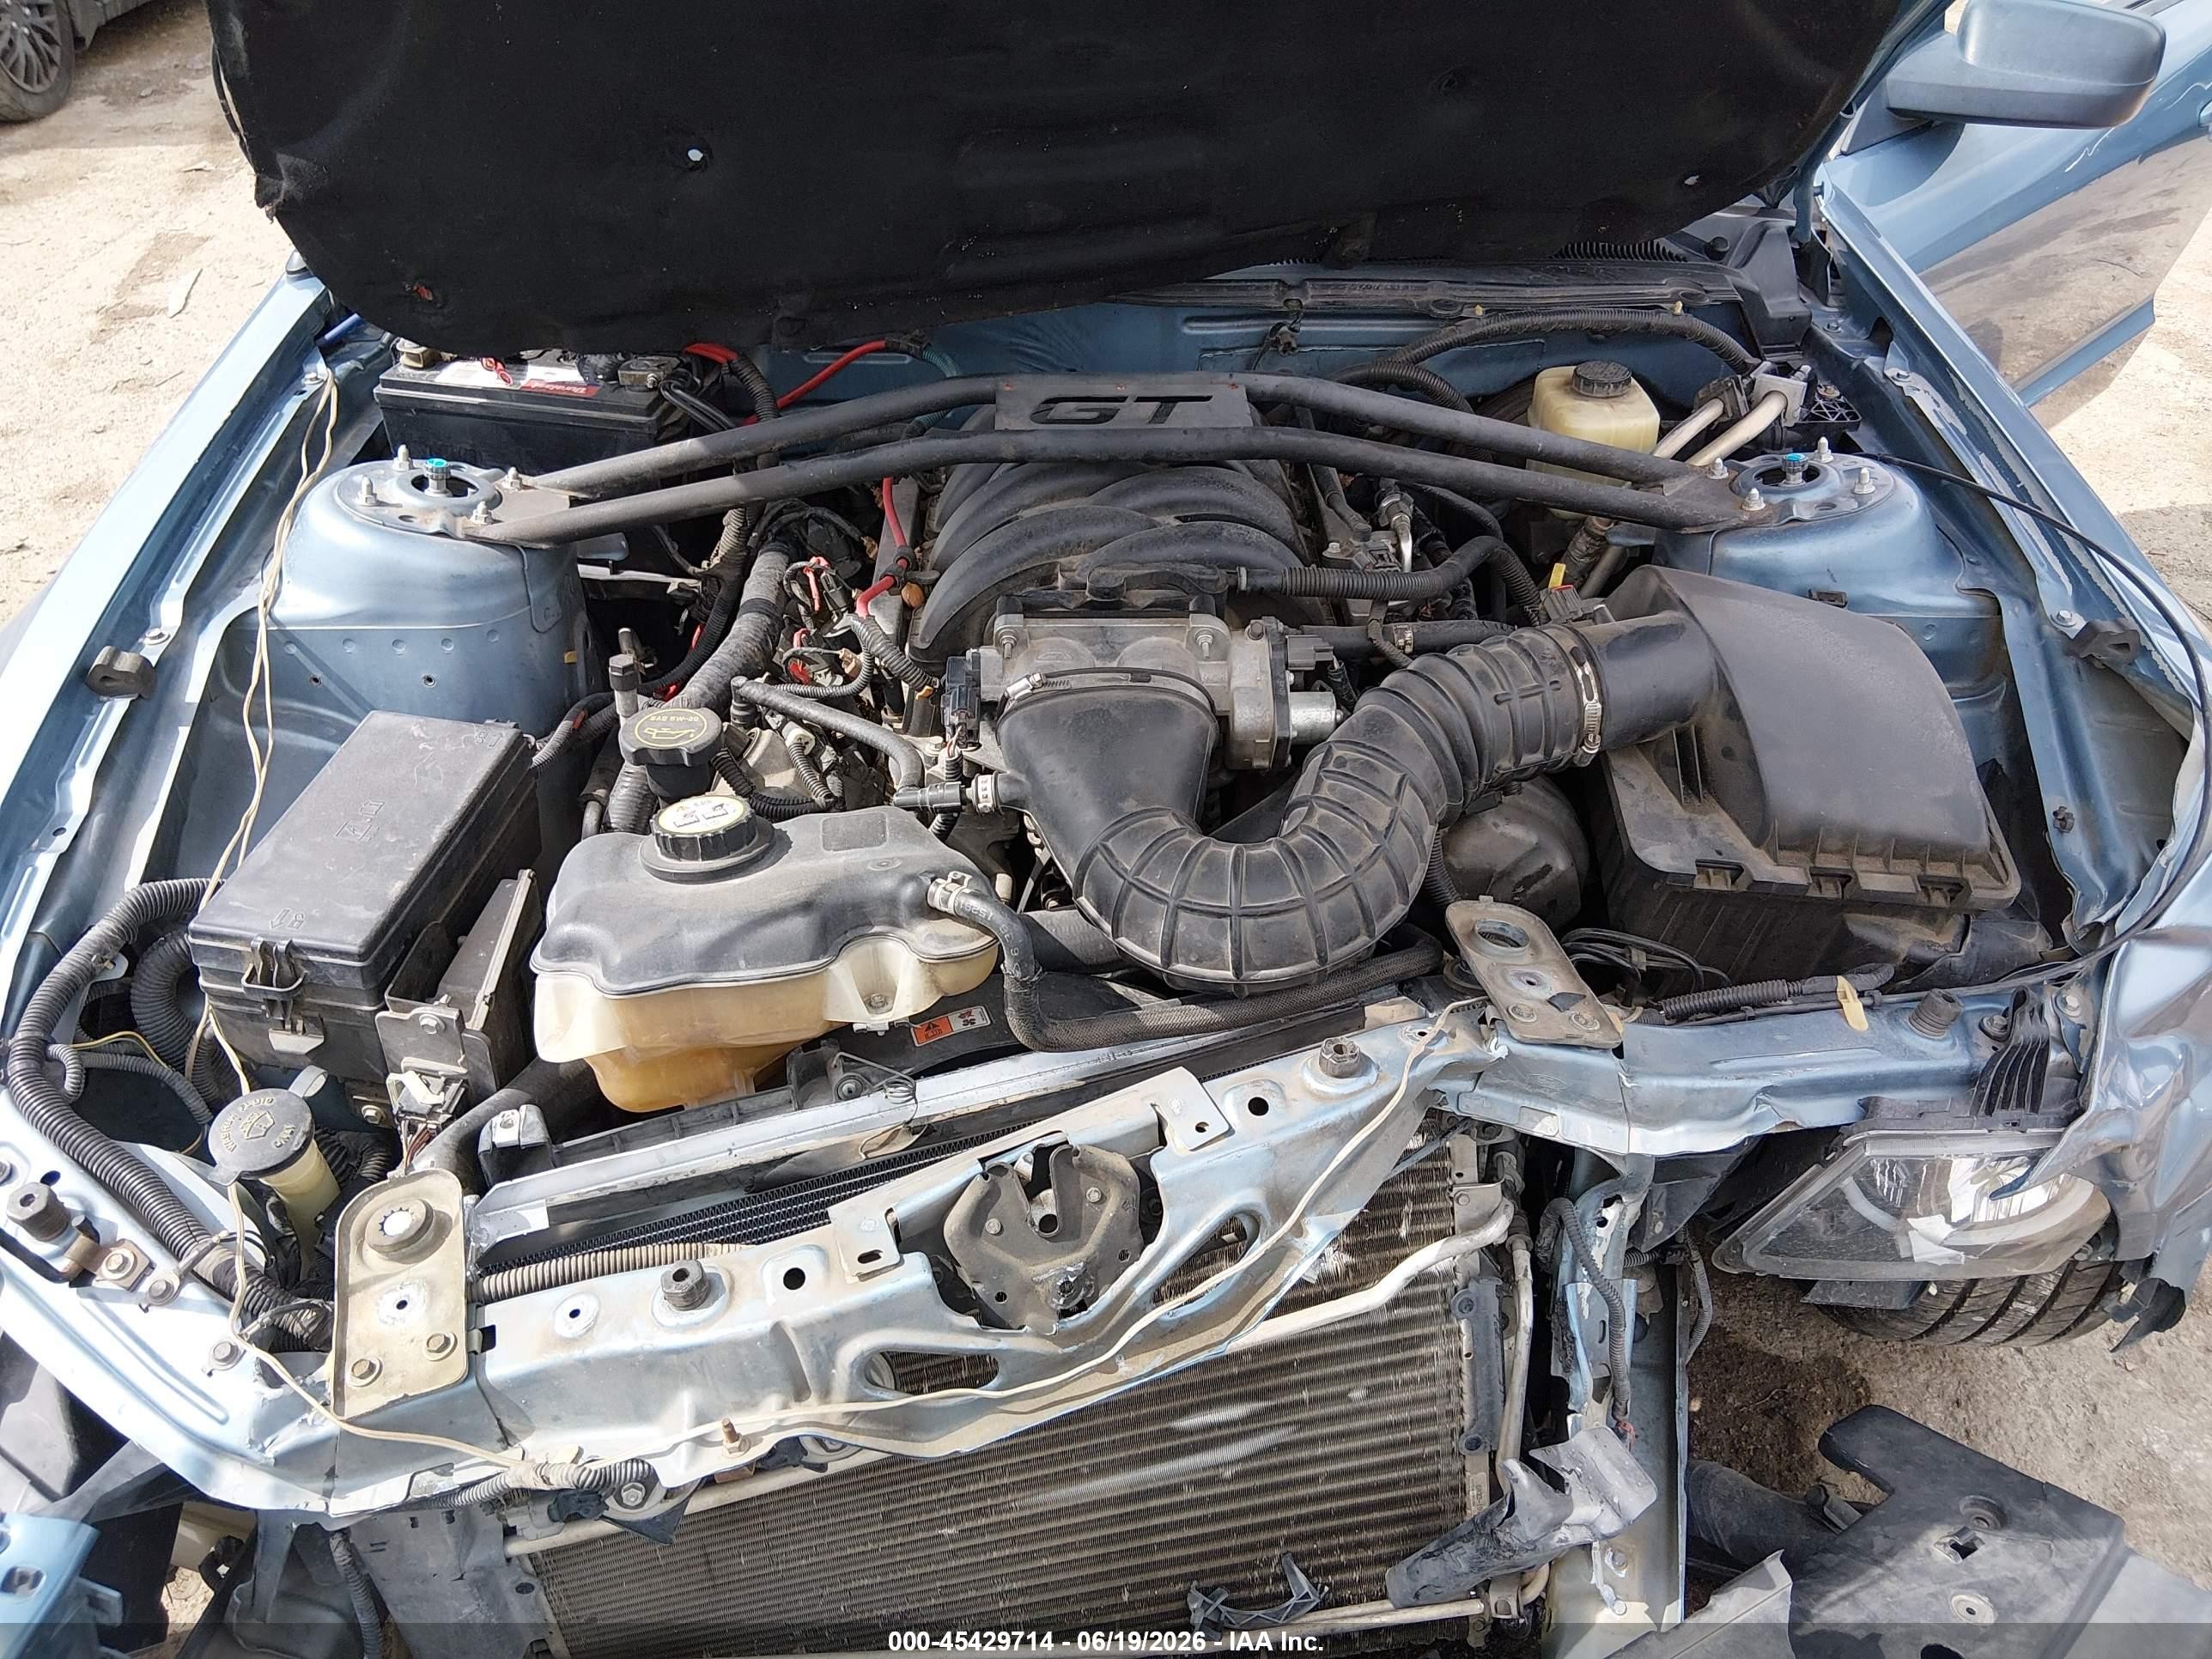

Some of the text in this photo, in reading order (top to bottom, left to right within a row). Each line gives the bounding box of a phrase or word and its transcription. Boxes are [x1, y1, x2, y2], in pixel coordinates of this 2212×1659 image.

[530, 383, 586, 394] Duralast
[1030, 395, 1212, 424] GT
[240, 1097, 274, 1111] FLUID
